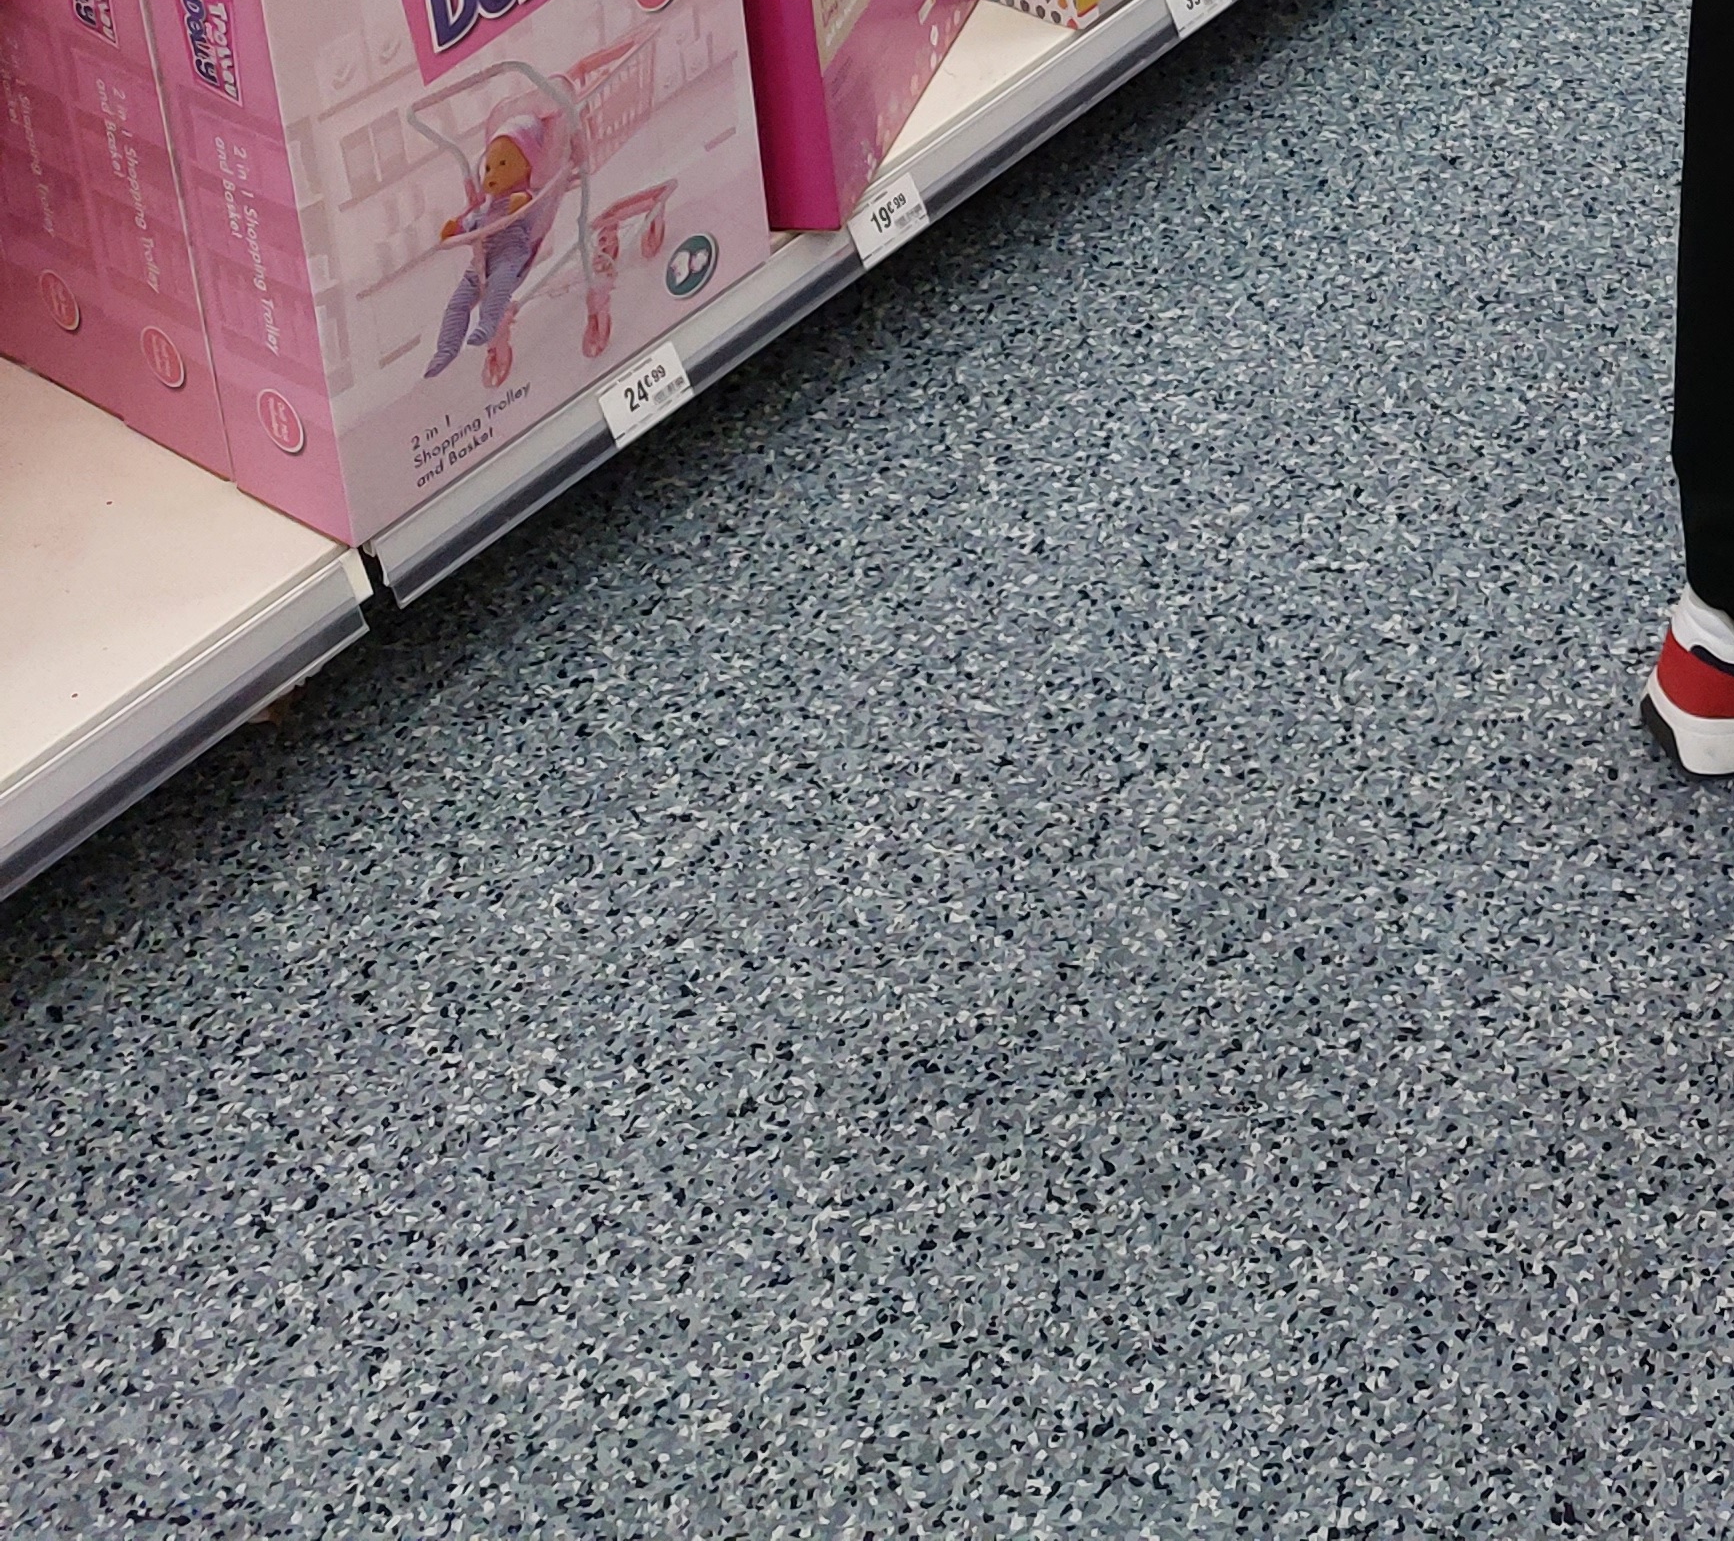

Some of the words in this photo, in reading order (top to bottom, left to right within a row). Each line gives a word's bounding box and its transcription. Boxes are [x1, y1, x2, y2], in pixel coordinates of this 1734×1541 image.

[213, 136, 235, 176] and
[233, 144, 248, 158] 2
[235, 161, 252, 181] in
[119, 146, 151, 231] Shopping
[139, 235, 163, 295] Trolley
[220, 178, 244, 239] Basket
[239, 204, 273, 292] Shopping
[259, 295, 283, 357] Trolley
[410, 435, 421, 452] 2
[424, 426, 439, 442] in
[413, 418, 482, 469] Shopping
[484, 381, 531, 420] Trolley
[416, 458, 445, 488] and
[447, 426, 494, 466] Basket
